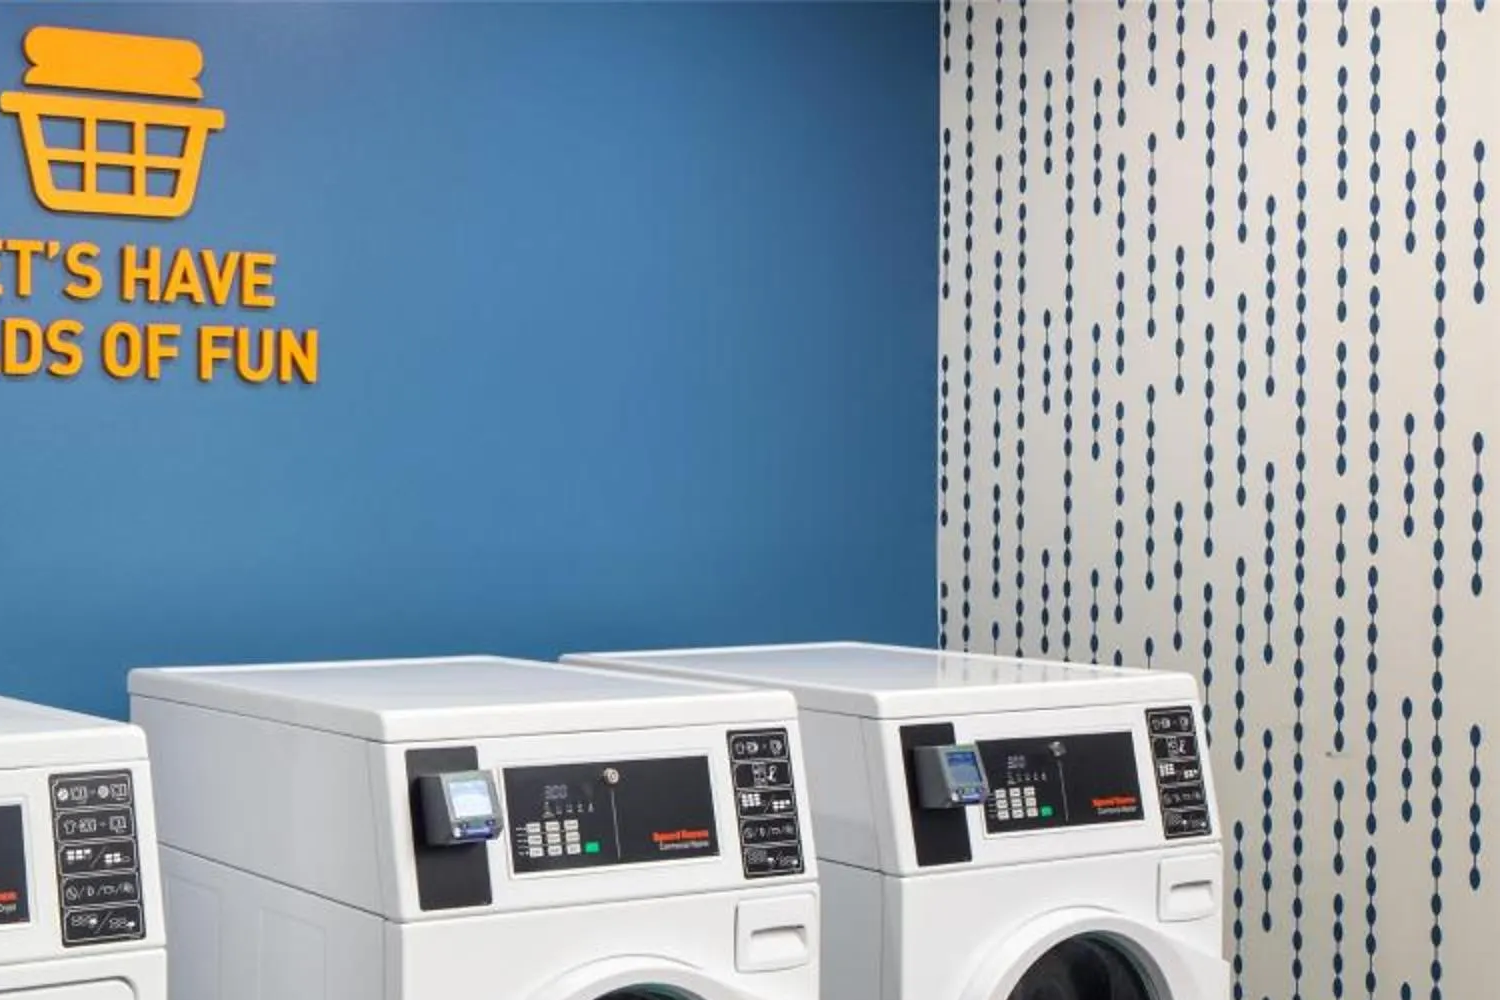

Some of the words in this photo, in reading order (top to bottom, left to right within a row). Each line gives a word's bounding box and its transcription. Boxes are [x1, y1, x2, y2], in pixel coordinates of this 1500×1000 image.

[120, 244, 278, 308] HAVE
[102, 320, 182, 380] OF
[199, 325, 318, 385] FUN
